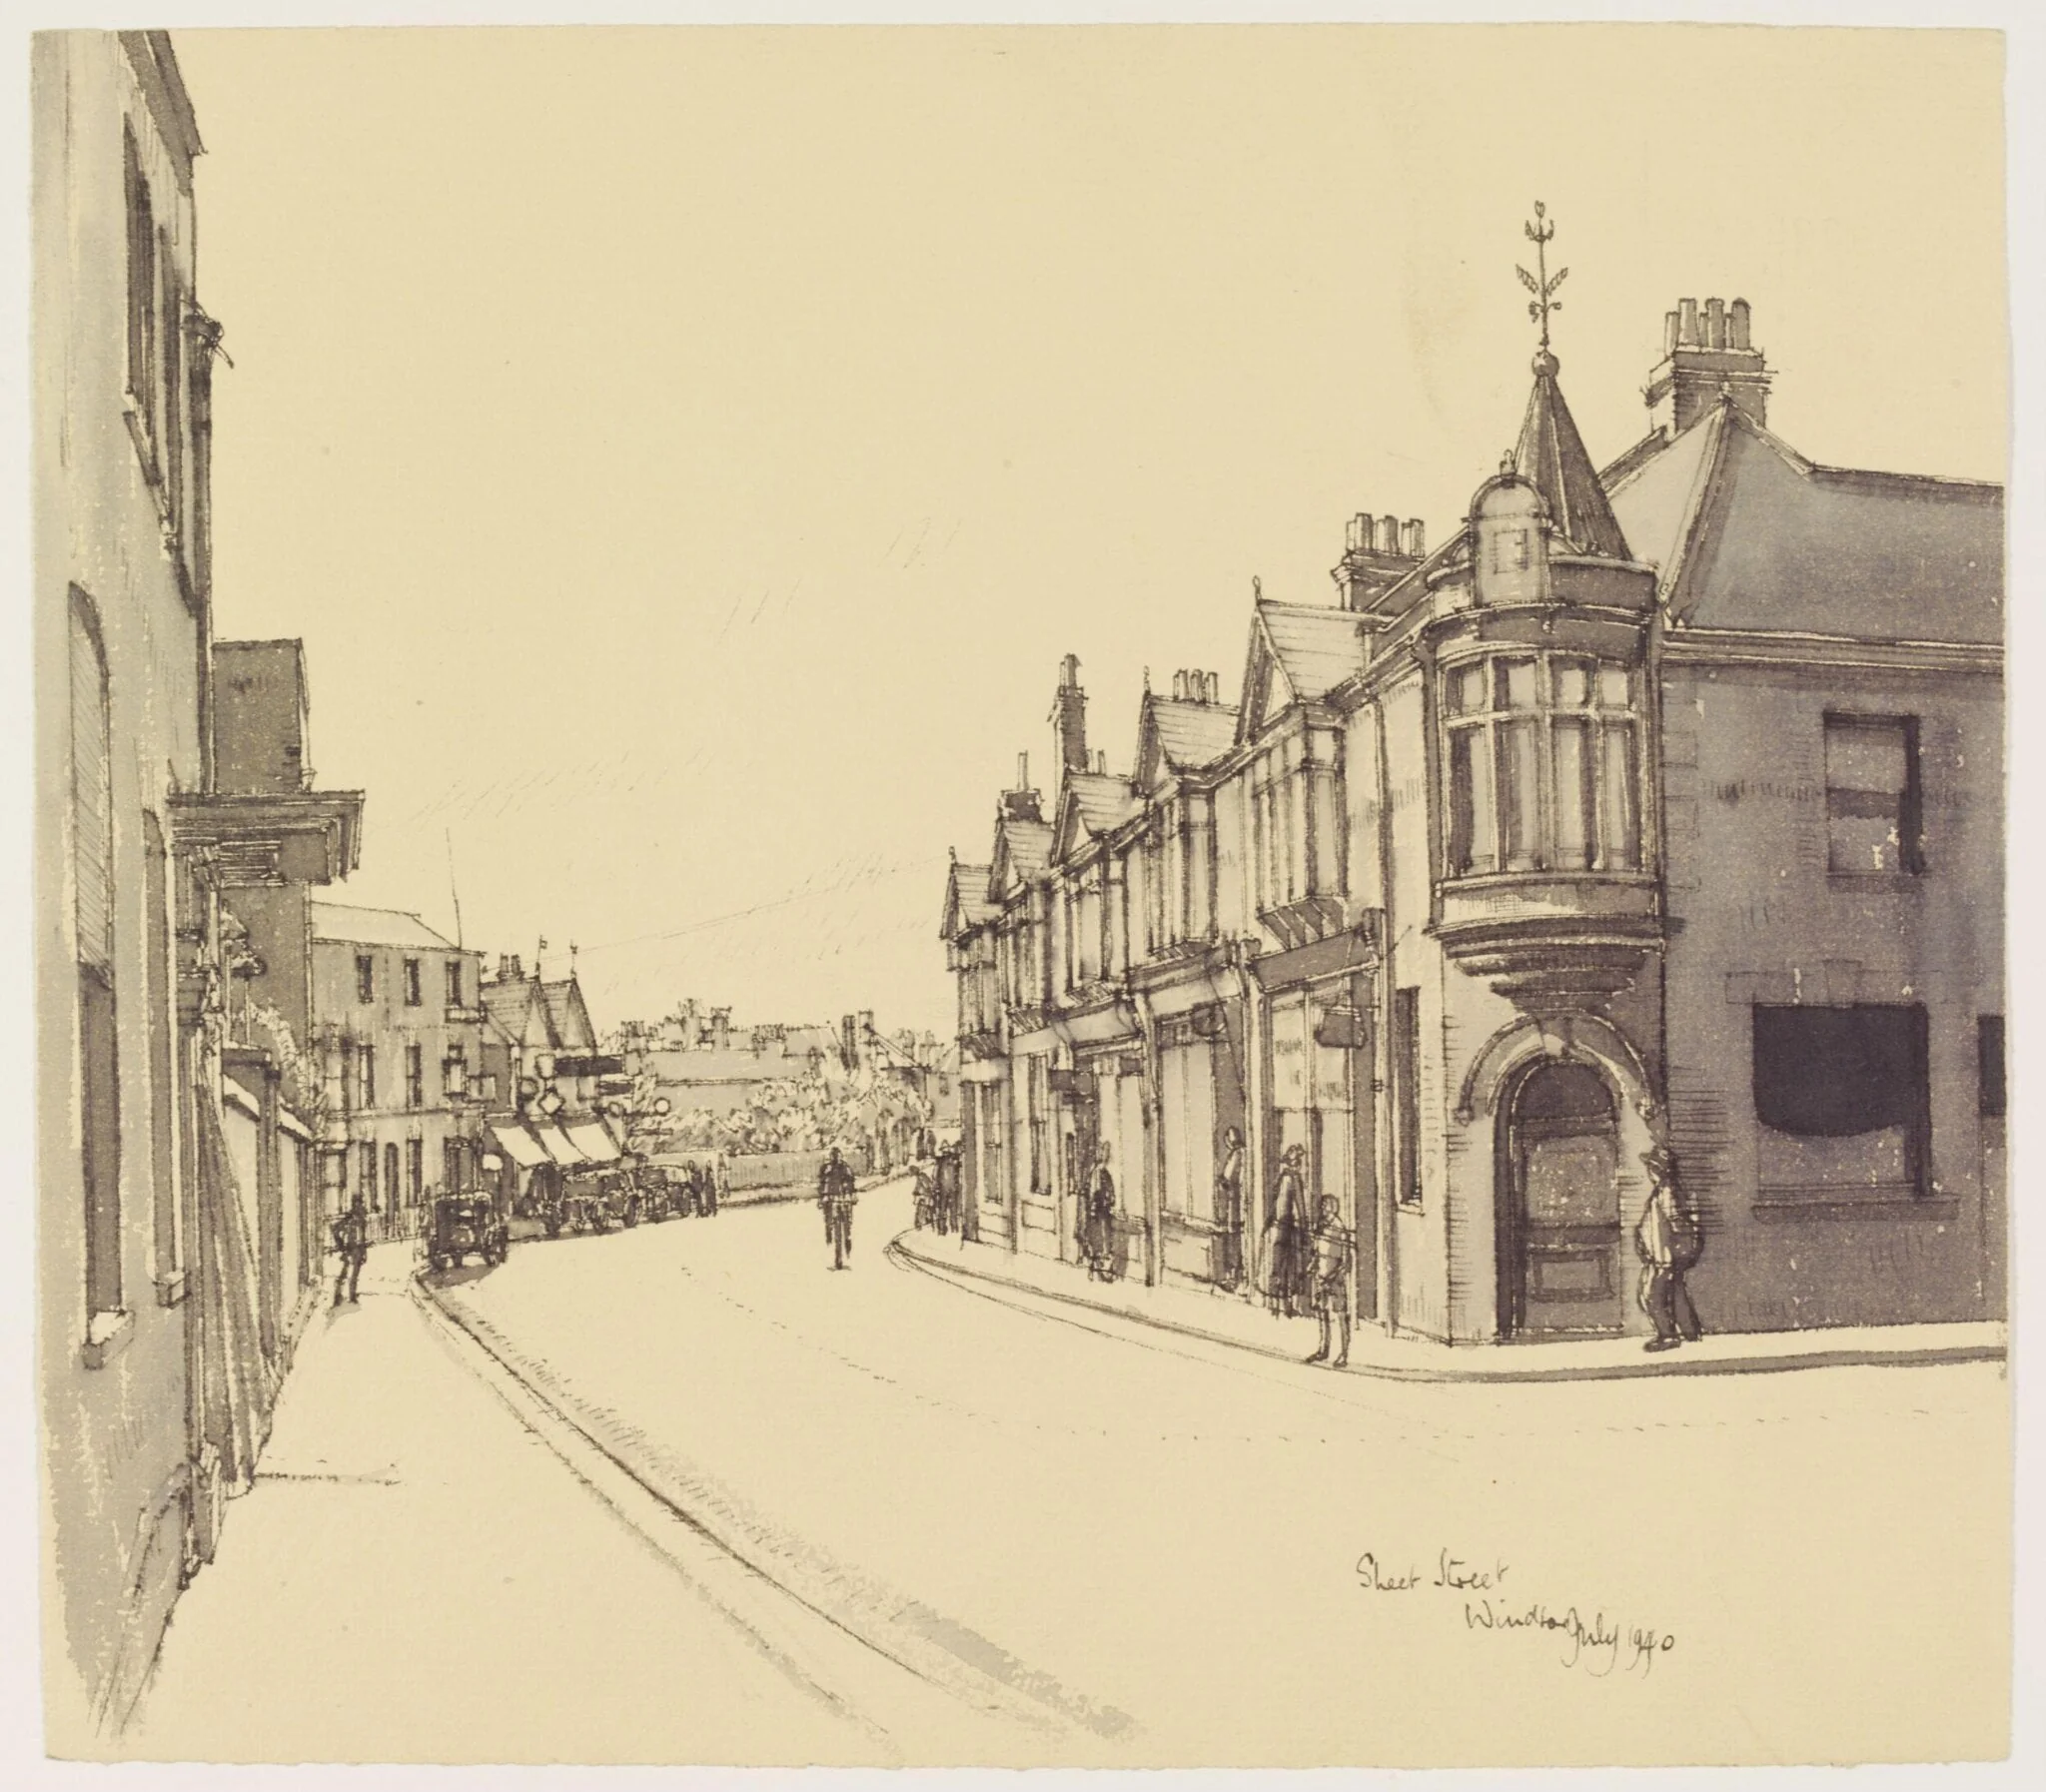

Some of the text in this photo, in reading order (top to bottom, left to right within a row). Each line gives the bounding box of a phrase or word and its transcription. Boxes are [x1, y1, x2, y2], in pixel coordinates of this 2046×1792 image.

[1356, 1547, 1510, 1590] Sheet Street
[1465, 1599, 1675, 1679] Windsor July 1940
